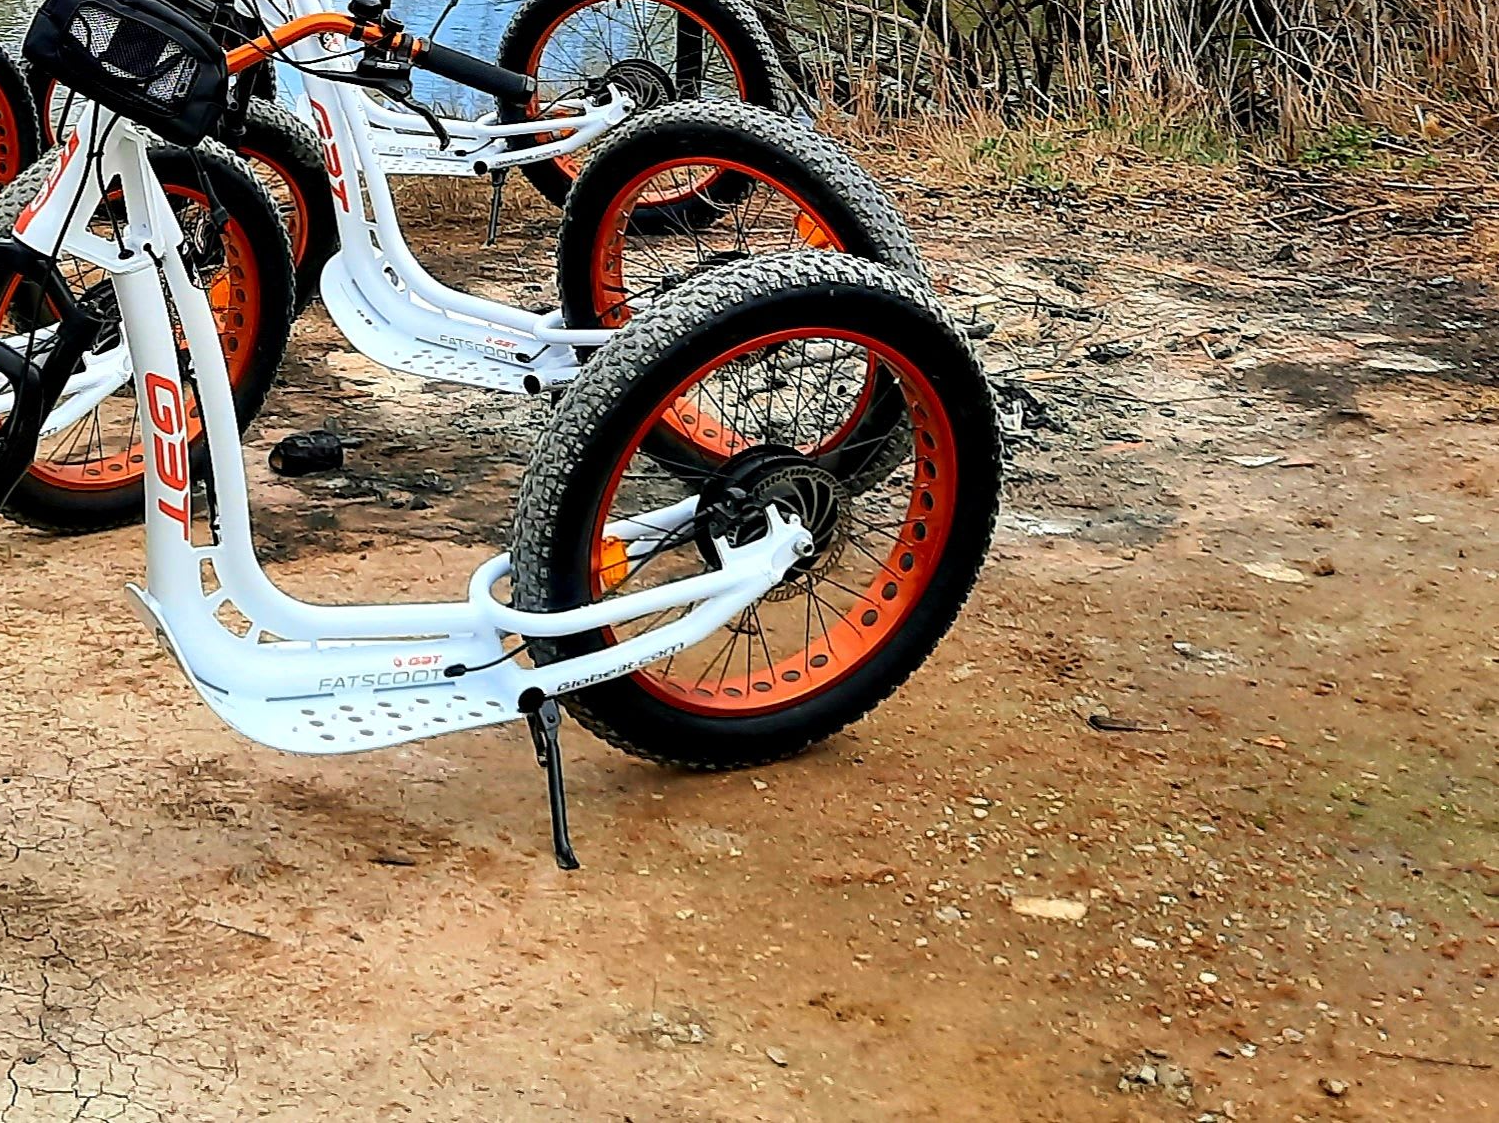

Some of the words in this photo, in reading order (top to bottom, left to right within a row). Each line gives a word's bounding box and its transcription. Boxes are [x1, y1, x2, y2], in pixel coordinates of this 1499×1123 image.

[440, 334, 516, 361] FATSCOOT
[145, 372, 189, 541] G3T
[318, 668, 443, 692] FATSCOOT
